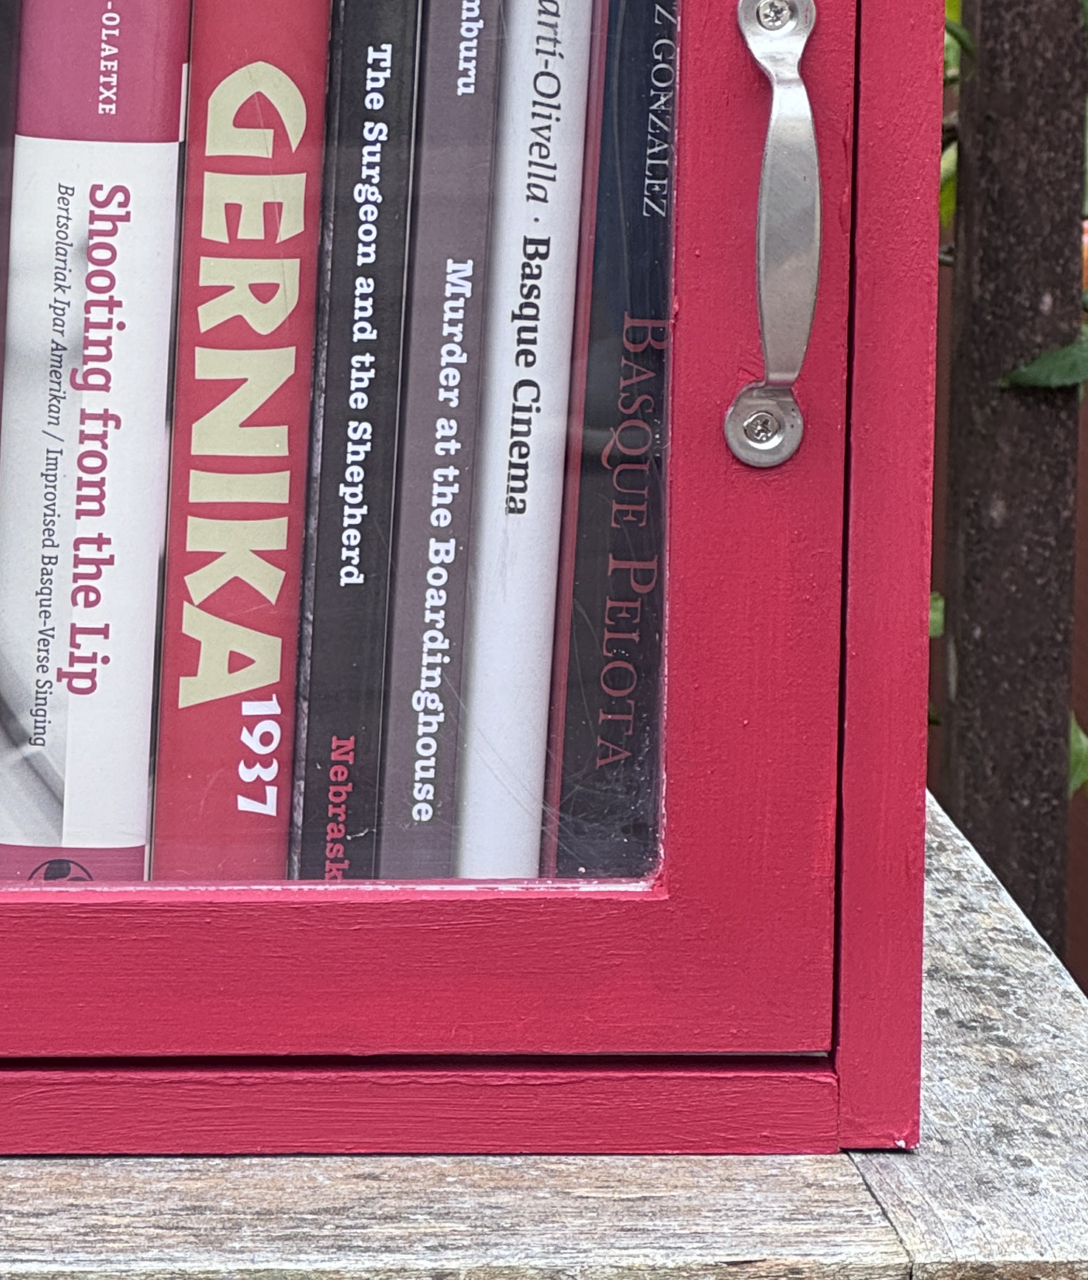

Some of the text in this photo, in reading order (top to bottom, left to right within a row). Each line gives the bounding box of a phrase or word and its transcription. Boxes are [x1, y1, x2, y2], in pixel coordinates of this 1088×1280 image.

[52, 182, 76, 293] Bertsolariak
[511, 235, 551, 368] Basque
[49, 297, 72, 337] Ipar
[339, 44, 393, 587] The Surgeon and the Shepherd
[47, 339, 68, 426] Amerikan
[56, 183, 132, 697] Shooting from the Lip
[178, 60, 307, 709] GERNIKA
[40, 448, 64, 549] Improvised
[505, 378, 541, 516] Cinema
[411, 259, 474, 822] Murder at the Boardinghouse
[595, 315, 670, 770] BASQUE PELOTA
[36, 551, 60, 674] Basque-Verse
[29, 677, 53, 747] Singing
[236, 693, 283, 817] 1937
